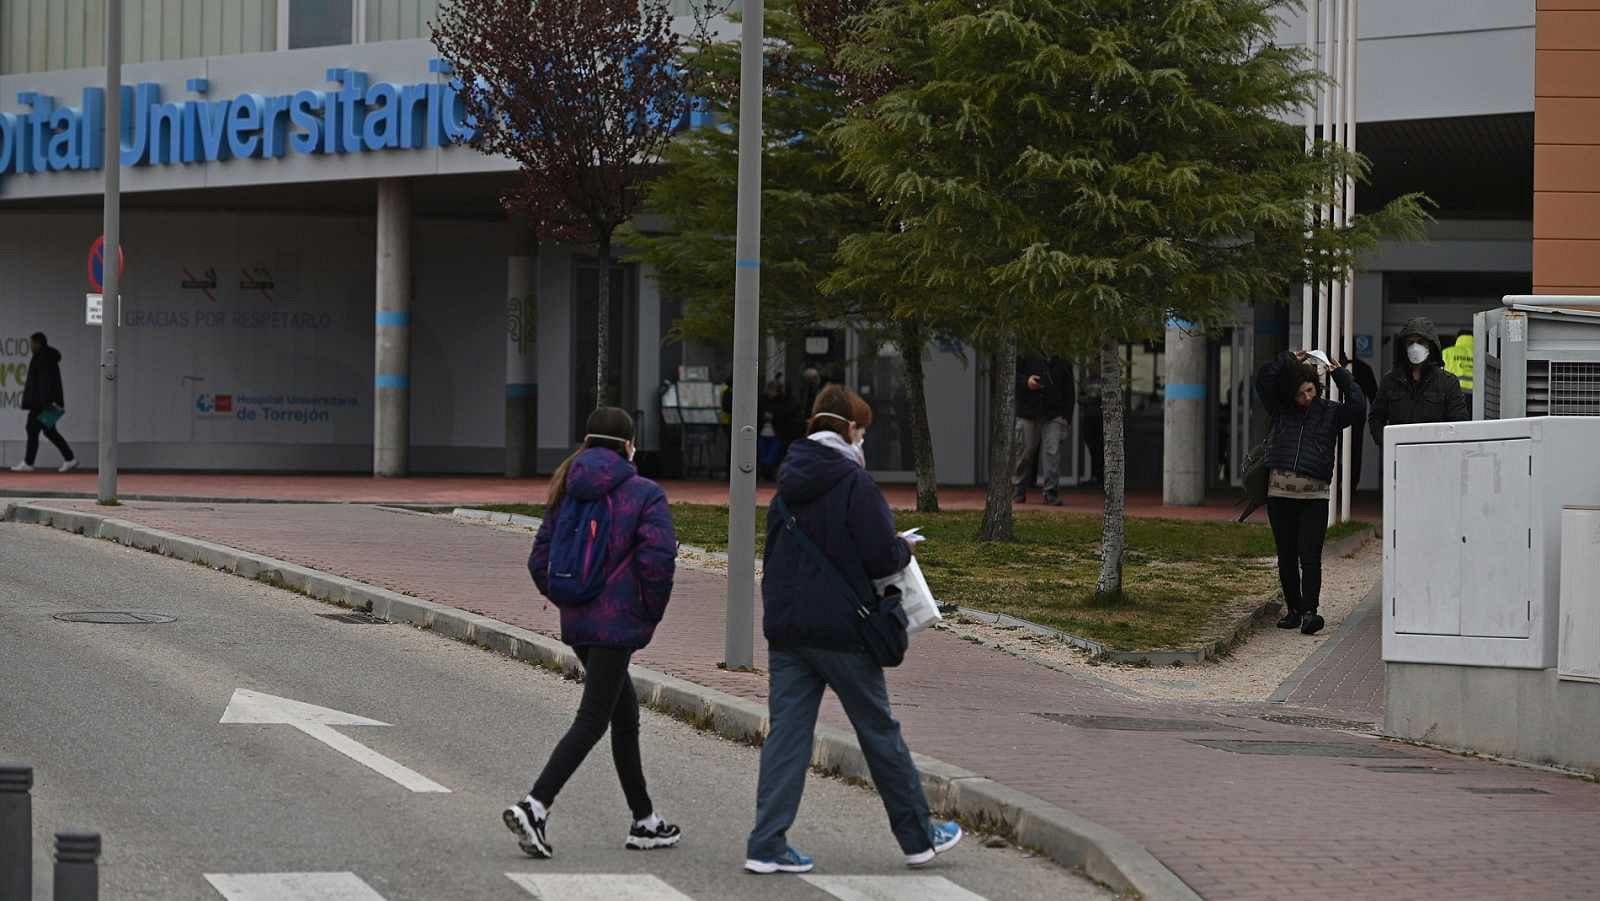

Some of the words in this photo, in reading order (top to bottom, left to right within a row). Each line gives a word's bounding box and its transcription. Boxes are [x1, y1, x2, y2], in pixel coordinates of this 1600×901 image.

[119, 58, 478, 167] Universitario
[125, 311, 190, 328] GRACIAS
[195, 311, 225, 328] POR
[231, 311, 333, 328] RESPETARLO
[237, 407, 257, 421] de
[262, 406, 329, 424] Torrejón
